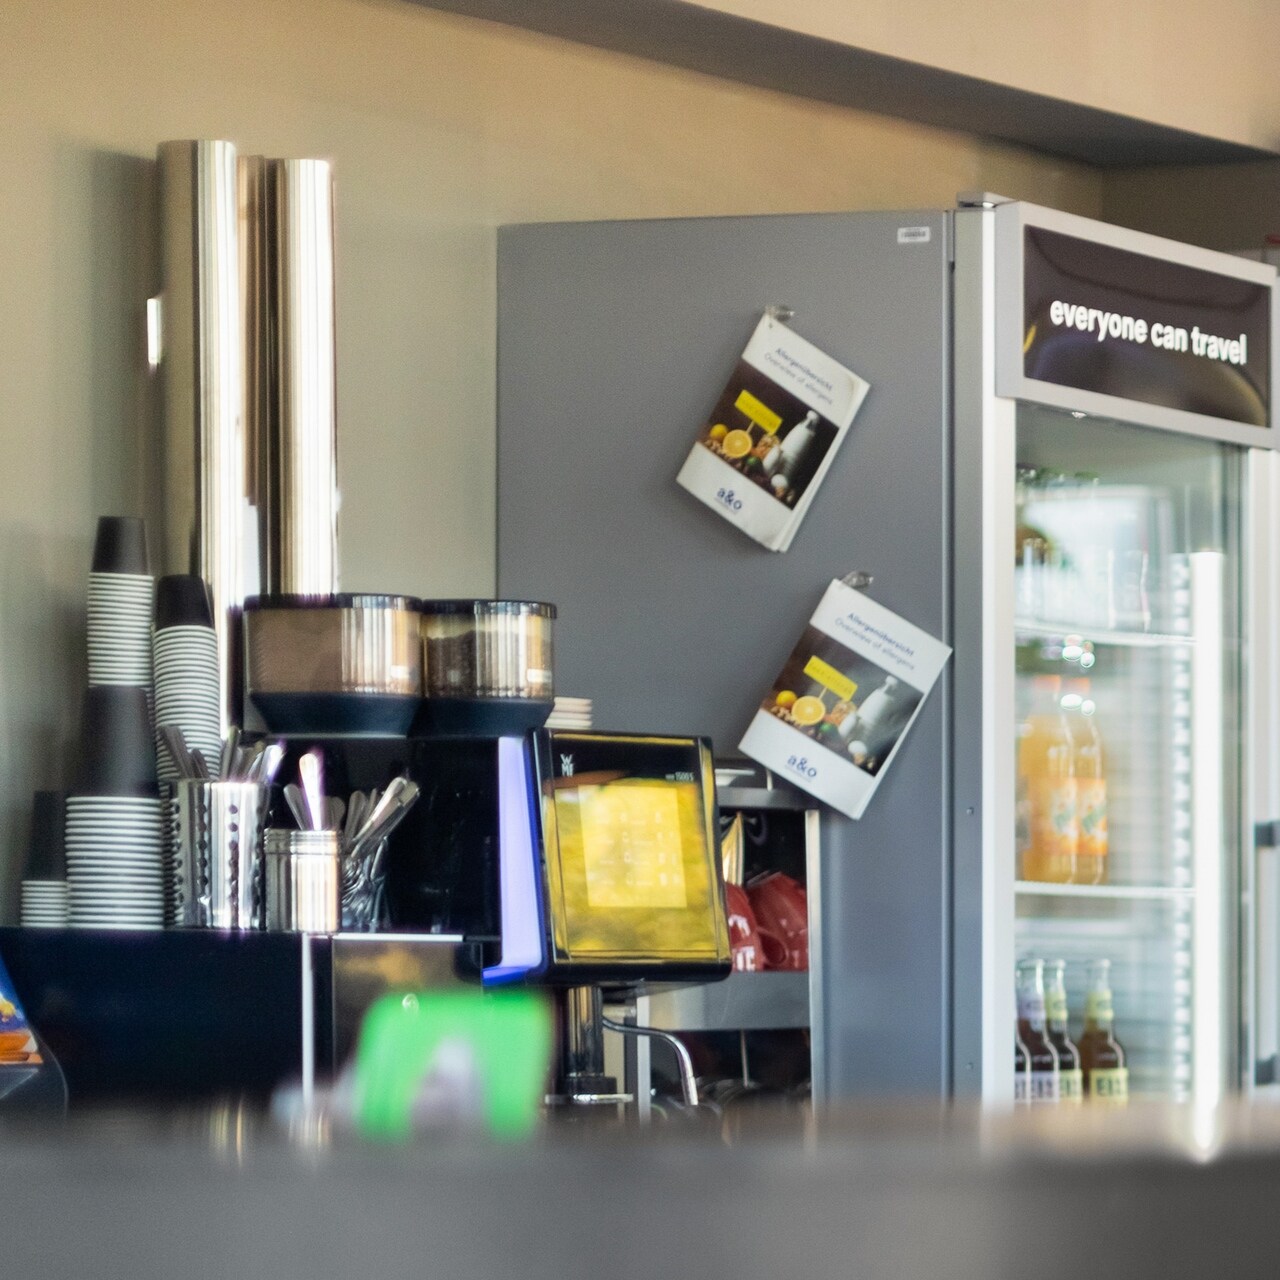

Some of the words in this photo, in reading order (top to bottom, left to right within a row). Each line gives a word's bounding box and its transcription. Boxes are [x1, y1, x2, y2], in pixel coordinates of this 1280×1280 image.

[1050, 300, 1148, 343] everyone
[1150, 322, 1188, 353] can
[1190, 326, 1248, 365] travel
[716, 487, 742, 510] a&o
[787, 755, 817, 778] a&o
